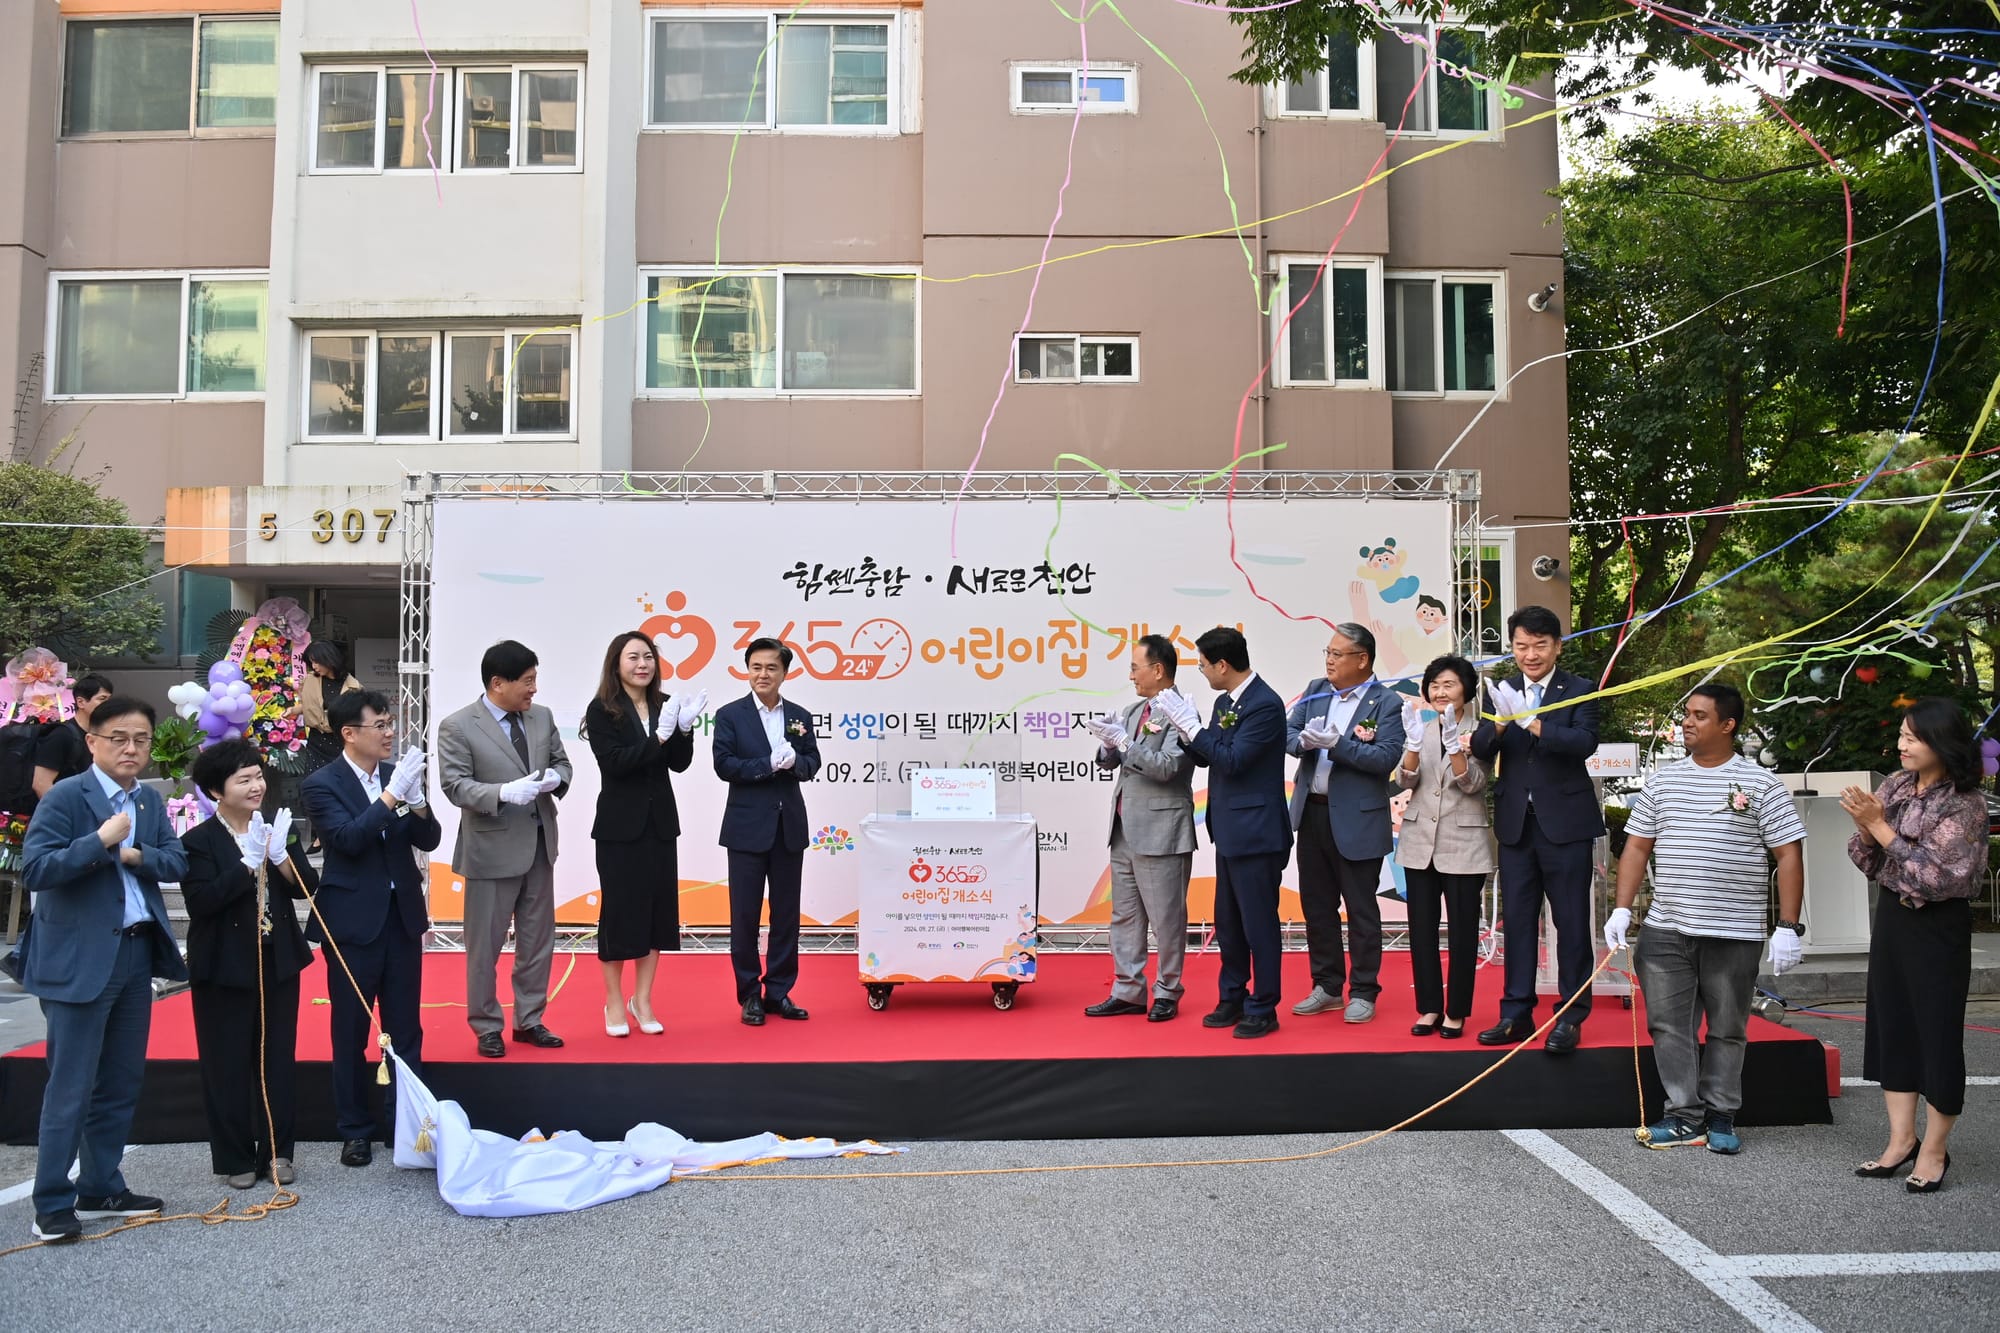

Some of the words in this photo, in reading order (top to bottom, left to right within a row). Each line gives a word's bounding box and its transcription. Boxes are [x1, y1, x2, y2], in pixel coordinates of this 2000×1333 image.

[258, 512, 277, 541] 5
[311, 508, 397, 543] 307
[783, 556, 911, 602] 힘쎈충남
[920, 619, 1090, 681] 어린이집
[838, 712, 908, 741] 성인이
[913, 712, 938, 741] 될
[947, 711, 1018, 736] 때까지
[1023, 711, 1106, 739] 책임지
[1603, 757, 1631, 768] 개소식
[1037, 831, 1068, 846] 안시
[934, 865, 968, 883] 365
[902, 887, 950, 905] 어린이집
[952, 889, 993, 905] 개소식
